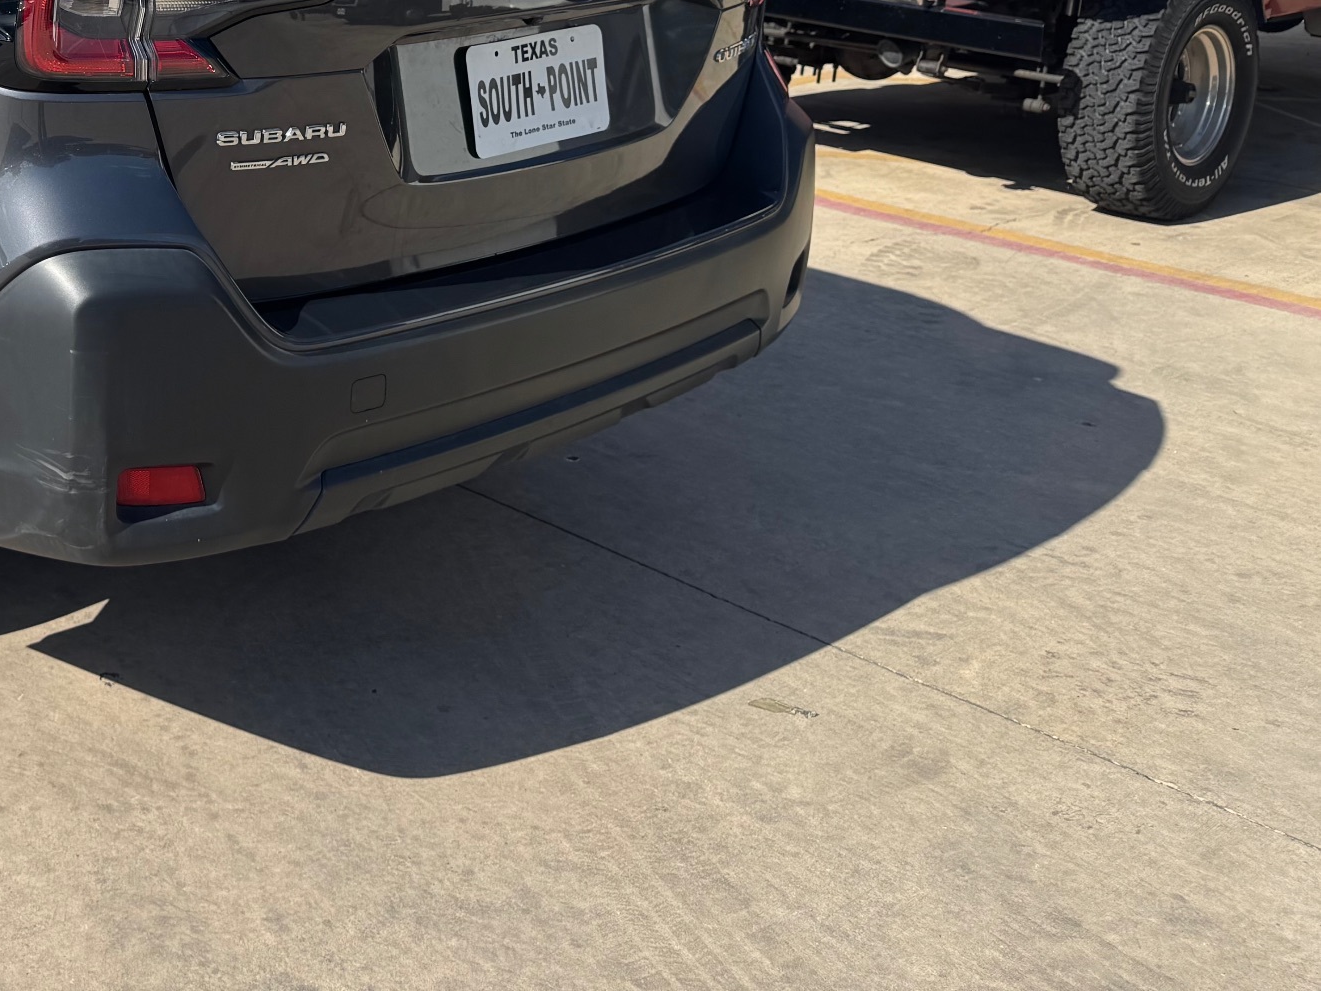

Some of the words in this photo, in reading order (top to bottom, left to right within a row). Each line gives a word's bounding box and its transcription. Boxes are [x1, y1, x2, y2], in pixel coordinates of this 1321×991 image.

[1194, 3, 1253, 56] BFGoodrich
[511, 37, 558, 64] TEXAS
[477, 70, 535, 128] SOUTH
[546, 57, 598, 111] POINT
[216, 122, 347, 147] SUBARU
[510, 131, 523, 139] The
[524, 126, 540, 135] Lone
[541, 123, 556, 131] Star
[557, 118, 576, 127] State
[269, 152, 330, 168] AWD
[1171, 154, 1228, 188] All-Terrain
